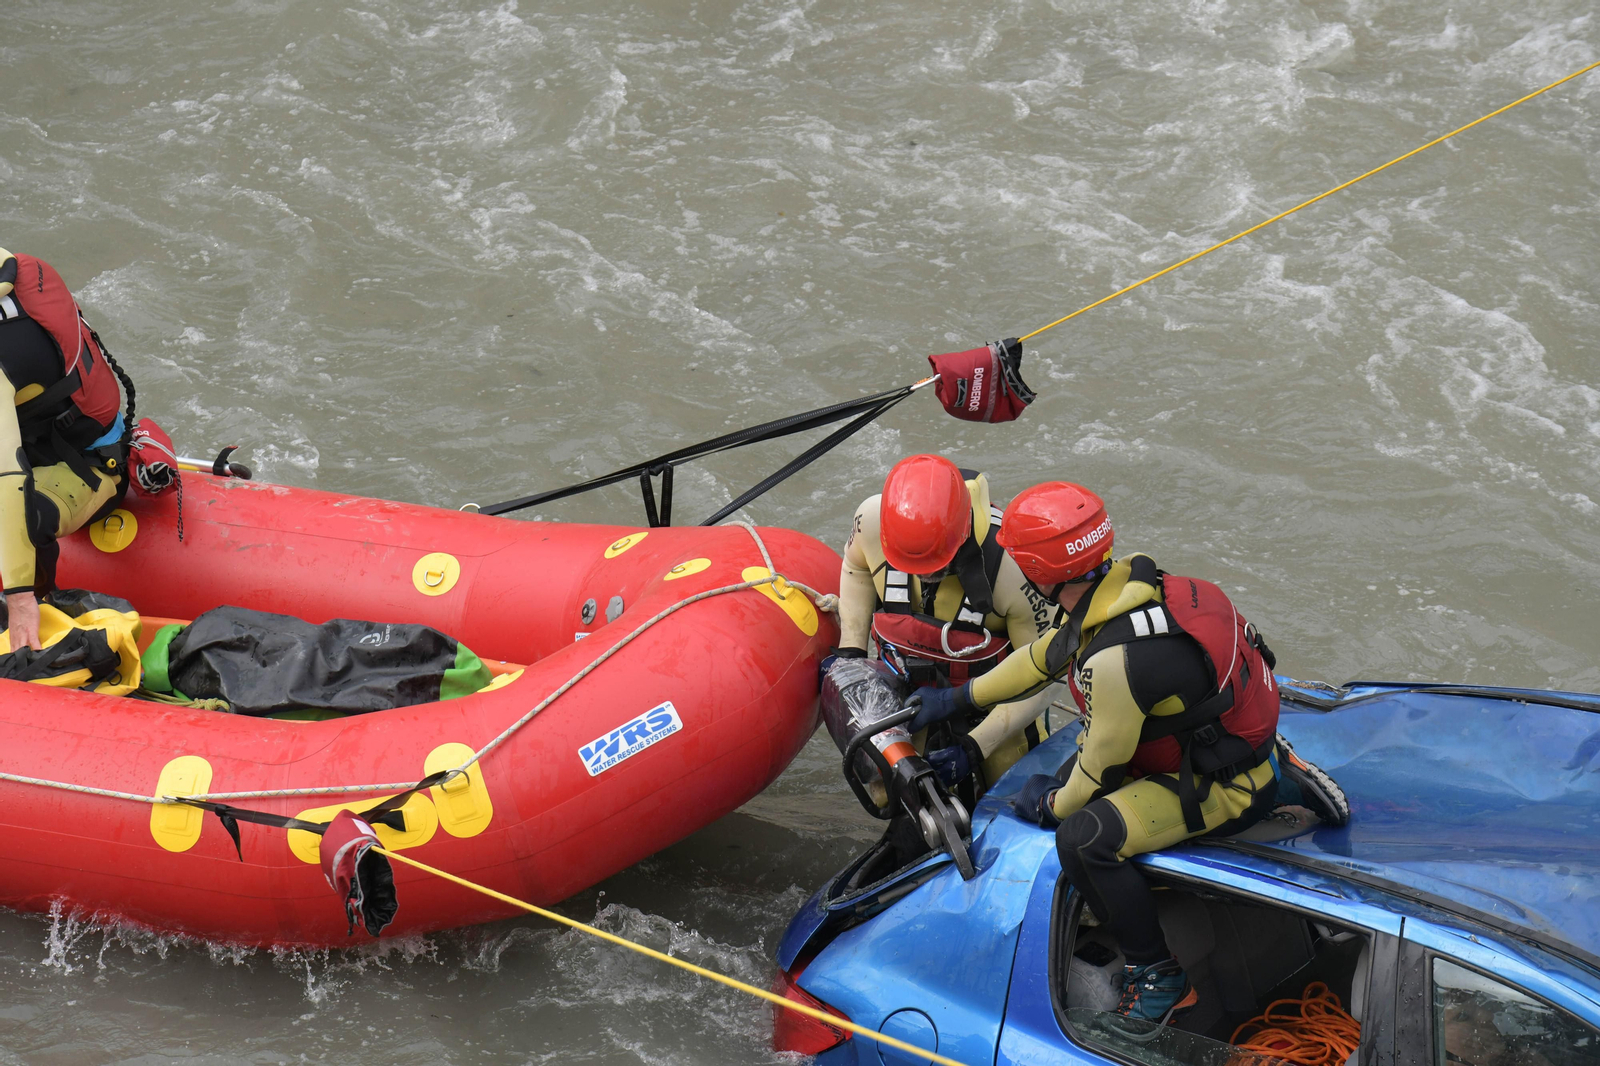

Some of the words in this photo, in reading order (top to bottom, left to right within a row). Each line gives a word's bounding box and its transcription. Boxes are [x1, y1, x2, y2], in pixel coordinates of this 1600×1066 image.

[968, 367, 985, 412] BOMBEROS
[579, 706, 673, 768] WRS
[591, 757, 617, 775] WATER
[617, 741, 646, 761] RESCUE
[645, 724, 677, 746] SYSTEMS
